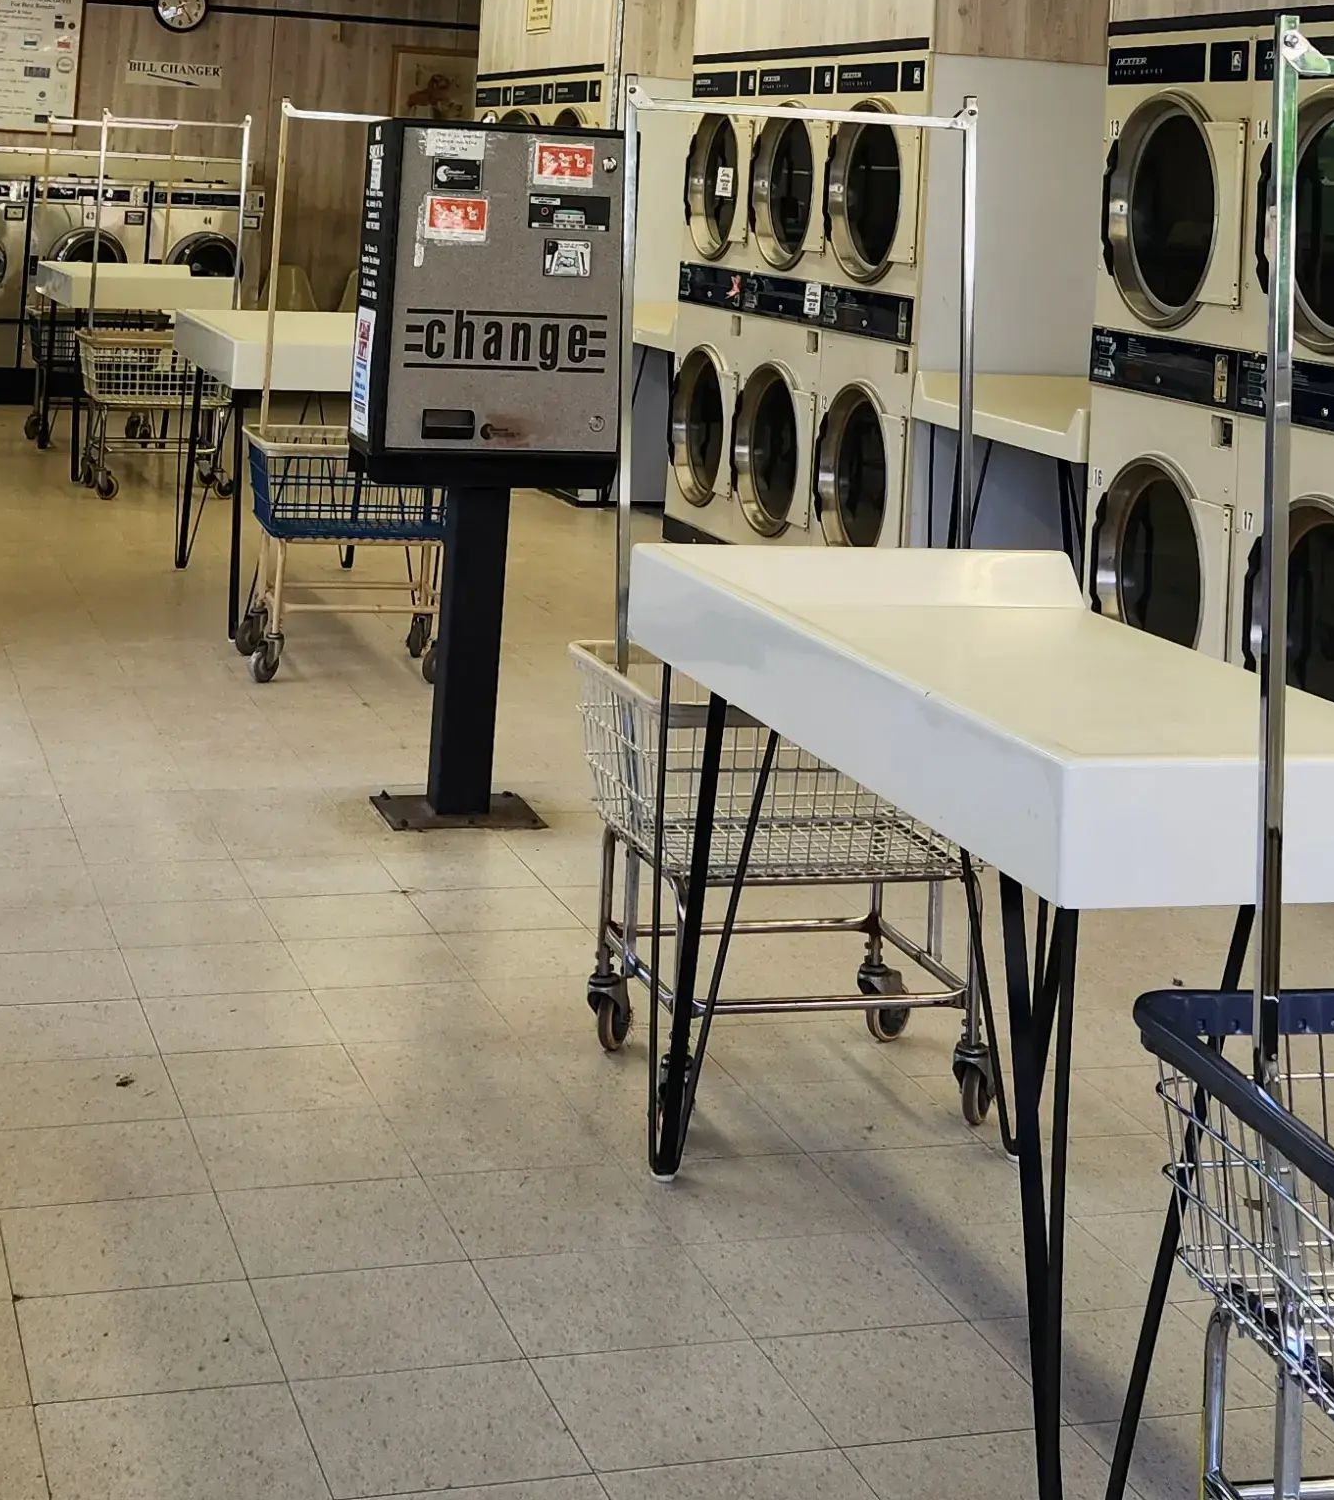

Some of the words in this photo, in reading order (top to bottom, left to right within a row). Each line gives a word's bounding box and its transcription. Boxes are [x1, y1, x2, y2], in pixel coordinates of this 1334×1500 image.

[129, 61, 156, 73] BILL
[160, 63, 220, 77] CHANGER
[1115, 57, 1148, 66] DEXTER
[1110, 120, 1120, 137] 13
[1258, 120, 1269, 139] 14
[85, 211, 95, 220] 43
[203, 217, 212, 226] 44
[424, 309, 588, 371] change
[1094, 469, 1102, 487] 16
[1243, 510, 1253, 531] 17
